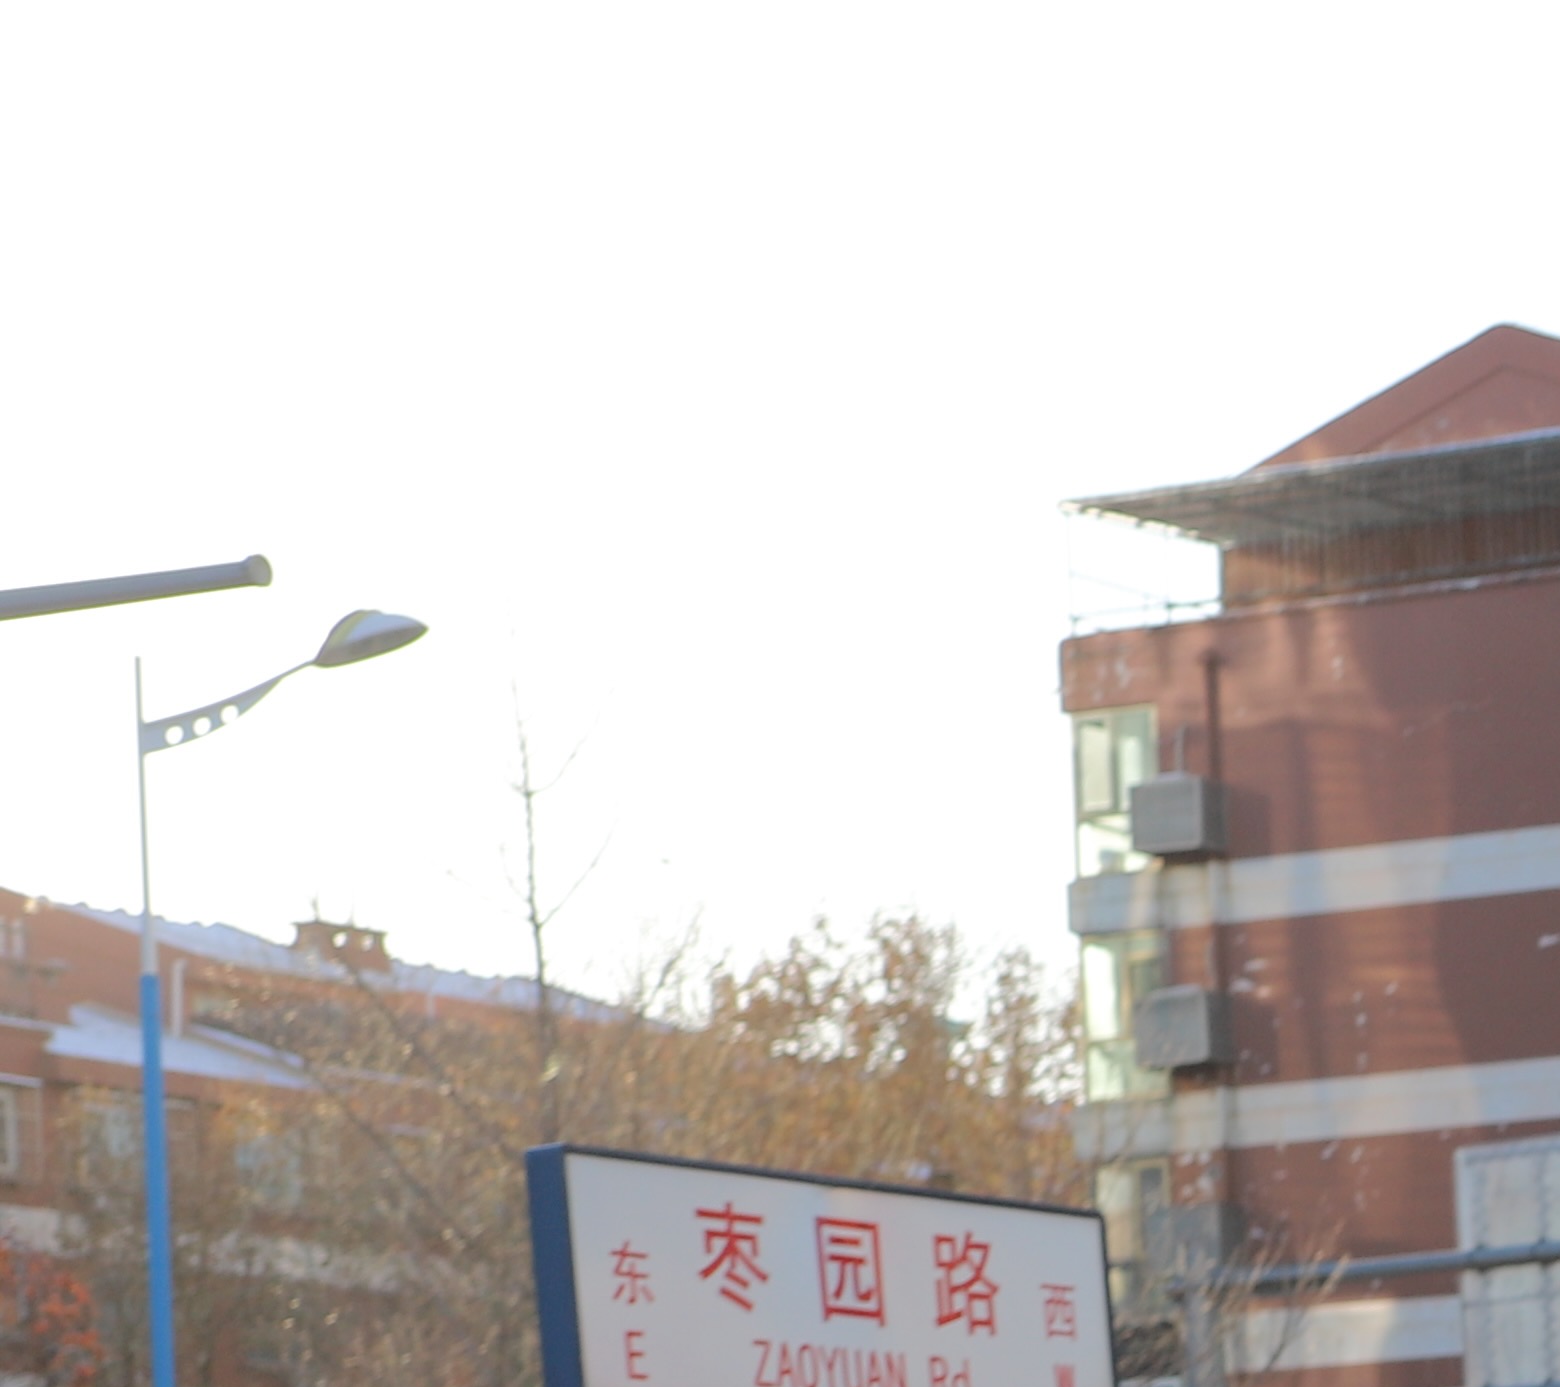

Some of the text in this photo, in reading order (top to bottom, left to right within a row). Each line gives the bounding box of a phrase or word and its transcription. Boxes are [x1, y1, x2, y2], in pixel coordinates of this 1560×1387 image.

[610, 1200, 1079, 1341] 东 枣园路 西
[624, 1330, 650, 1381] E
